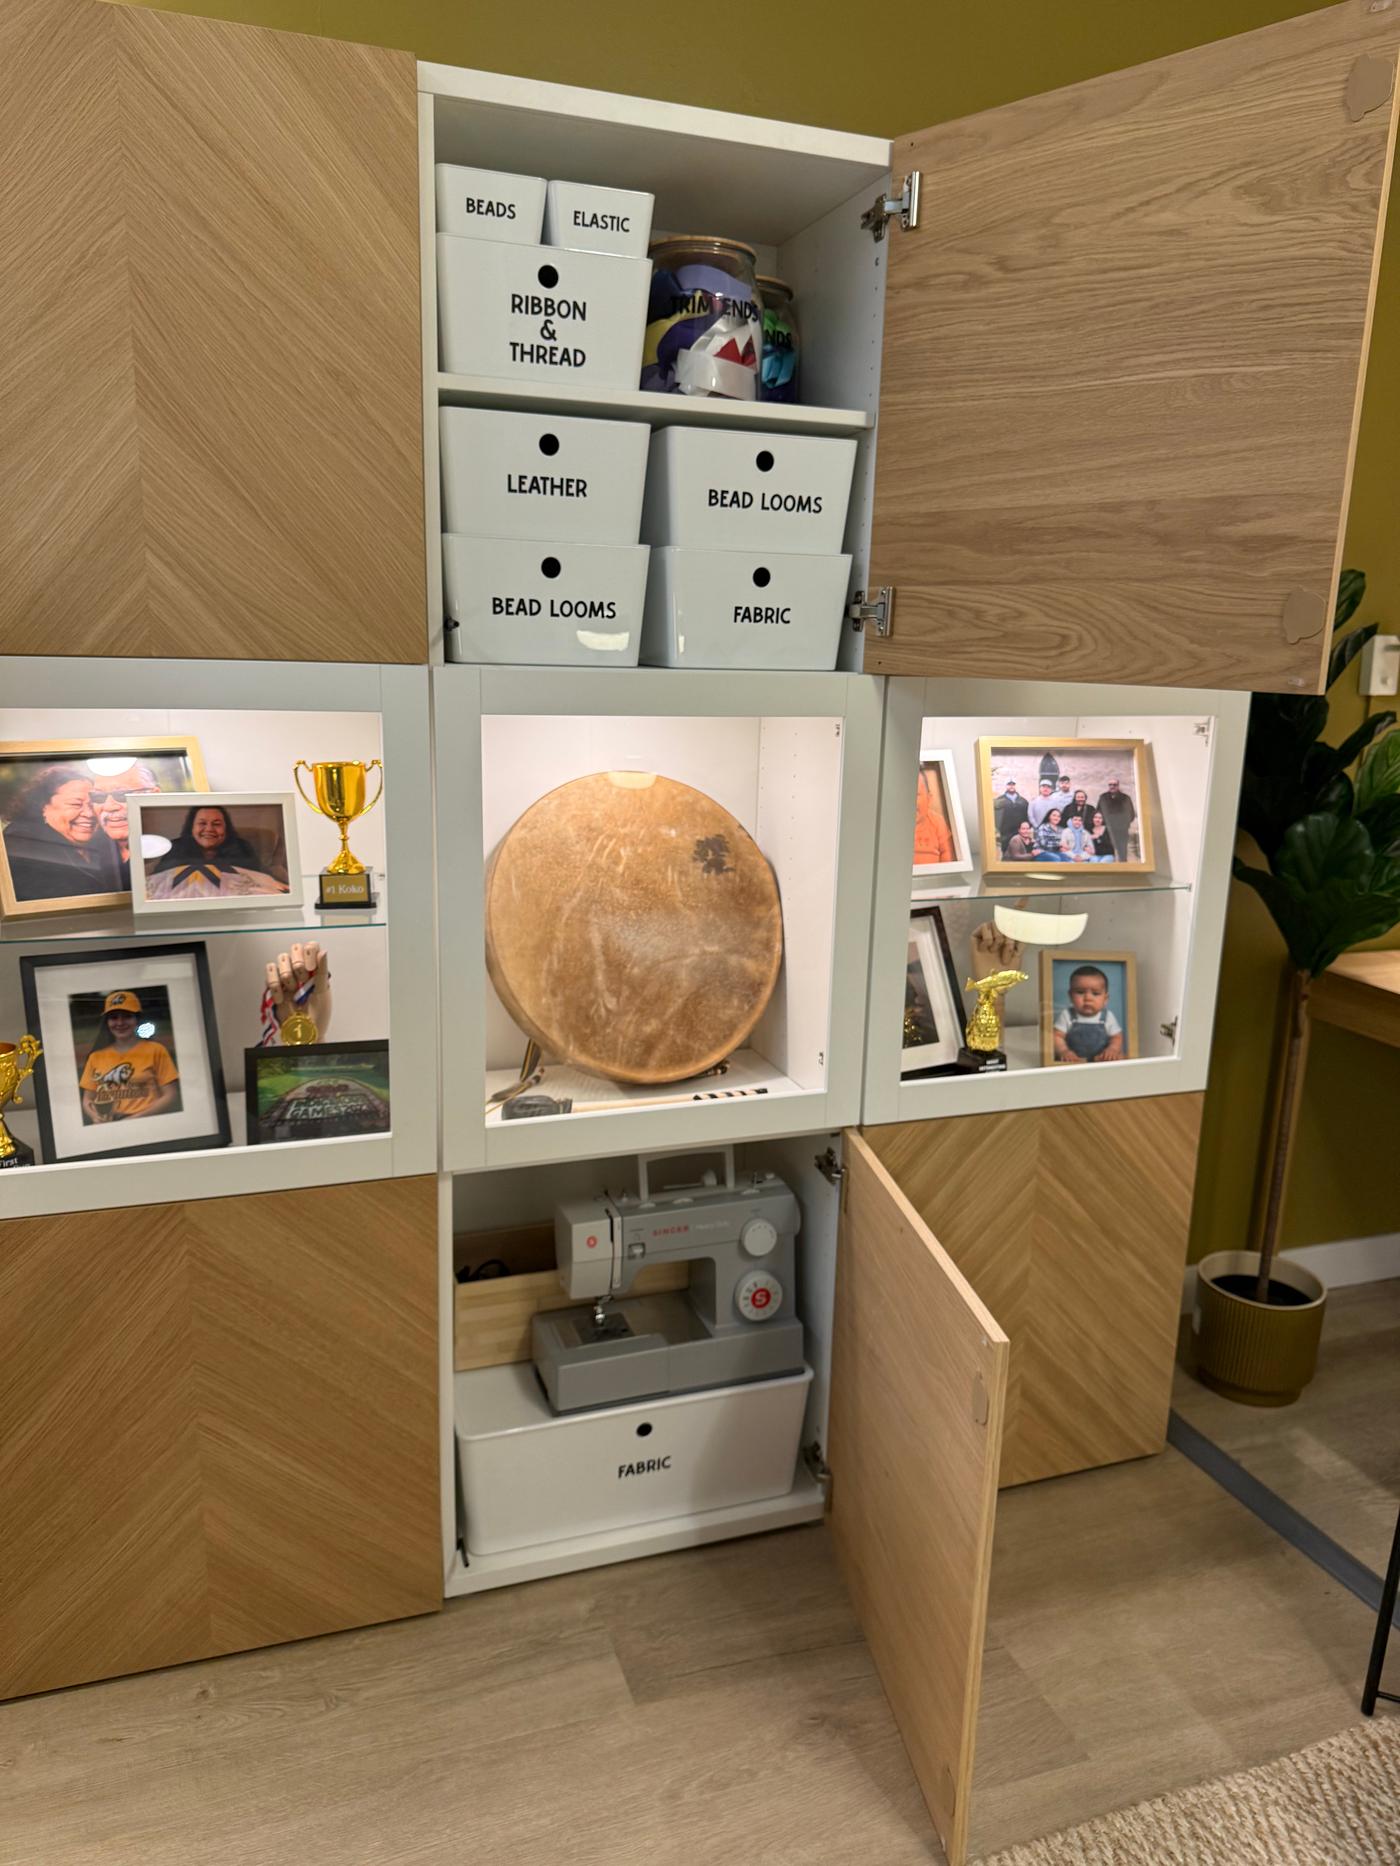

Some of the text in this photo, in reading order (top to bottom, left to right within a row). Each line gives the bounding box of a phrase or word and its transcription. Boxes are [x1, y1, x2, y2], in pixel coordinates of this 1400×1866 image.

[466, 197, 516, 220] BEADS
[573, 210, 630, 233] ELASTIC
[511, 293, 587, 322] RIBBON
[721, 297, 759, 322] ENDS
[540, 319, 557, 342] &
[763, 328, 793, 349] NDS
[509, 341, 587, 368] THREAD
[507, 473, 588, 498] LEATHER
[707, 488, 823, 514] BEAD LOOMS
[491, 596, 617, 620] BEAD LOOMS
[733, 605, 792, 625] FABRIC
[338, 884, 365, 896] Koko
[652, 1224, 690, 1237] SINGER
[617, 1455, 672, 1480] FABRIC
